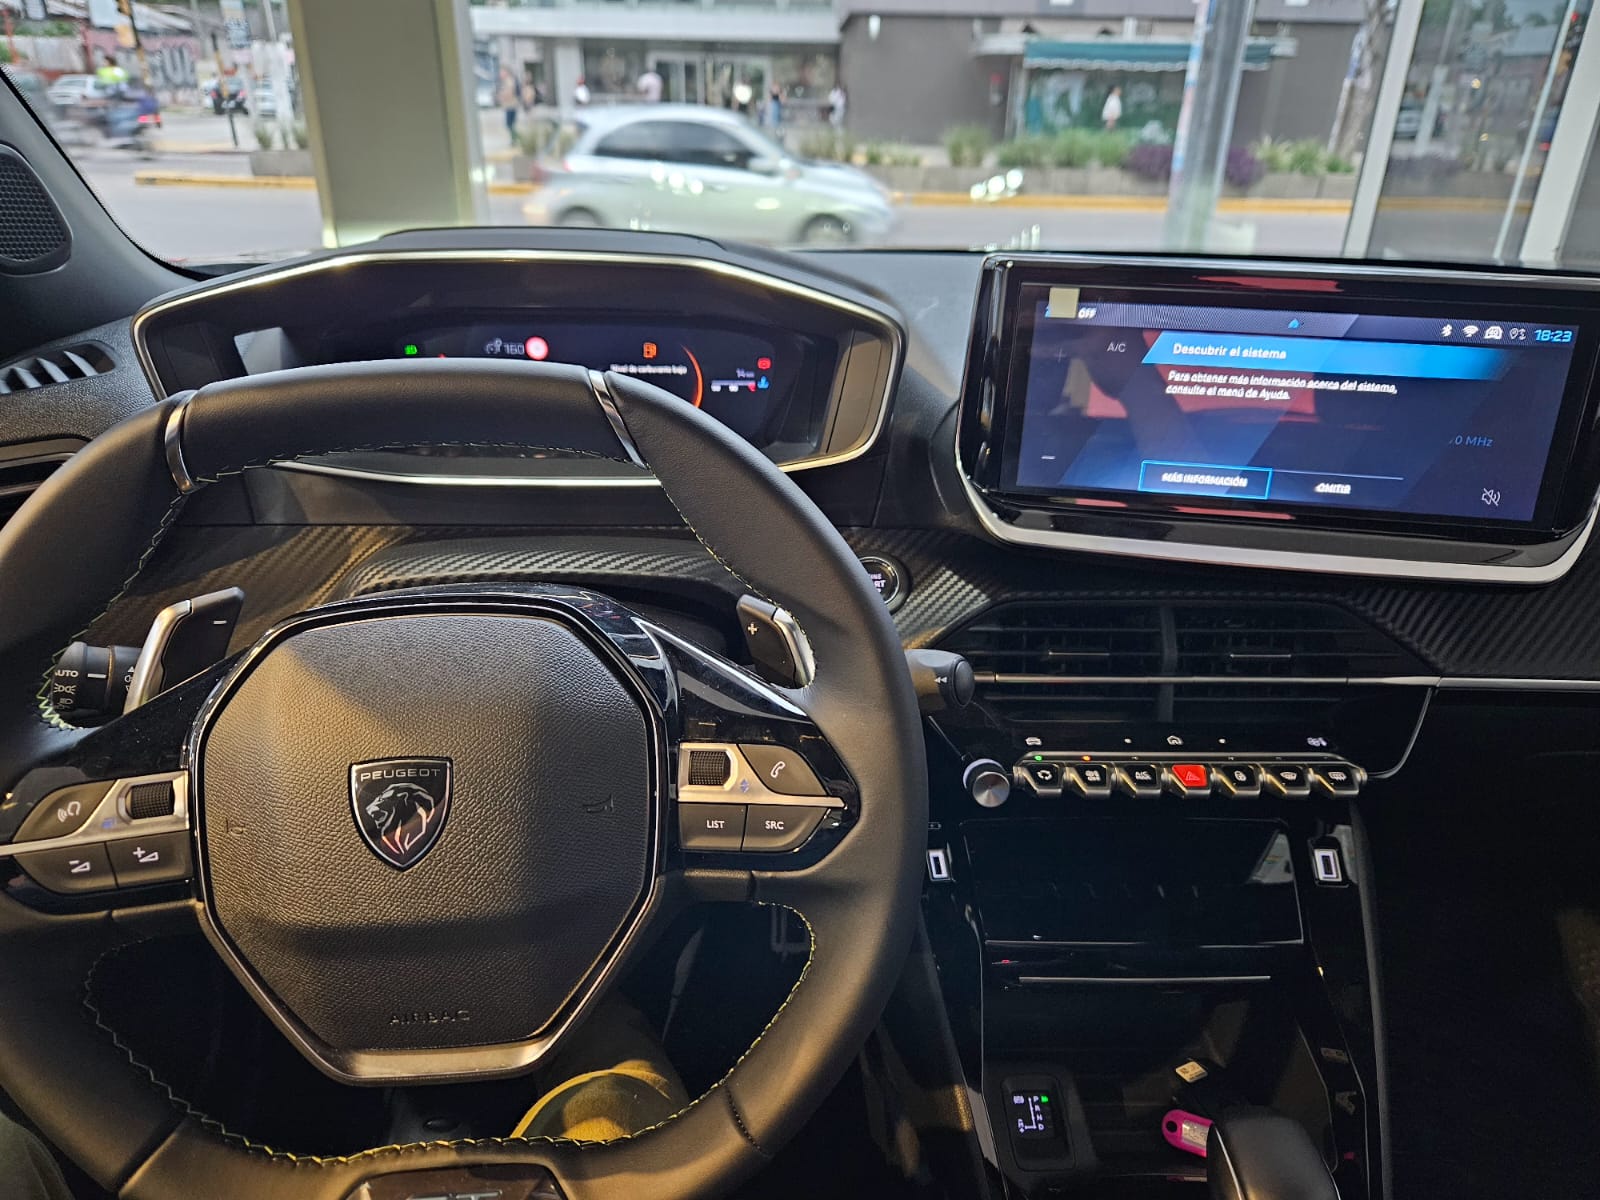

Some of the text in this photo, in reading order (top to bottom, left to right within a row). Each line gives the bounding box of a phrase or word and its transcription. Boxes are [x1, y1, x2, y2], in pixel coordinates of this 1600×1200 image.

[1535, 329, 1573, 342] 18:23
[1107, 342, 1126, 353] A/C
[1172, 343, 1287, 360] Descubrir el sistema
[1168, 370, 1191, 382] Para
[1190, 372, 1228, 384] obtener
[1228, 374, 1249, 386] más
[1249, 375, 1306, 388] información
[1306, 379, 1339, 390] acerca
[1340, 380, 1357, 391] del
[1165, 385, 1206, 396] consulte
[1206, 387, 1217, 396] el
[1217, 388, 1245, 398] menú
[1245, 388, 1259, 399] de
[1465, 436, 1493, 447] MHz
[1161, 472, 1248, 488] MÁS INFORMACIÓN
[360, 768, 441, 782] PEUGEOT
[706, 820, 725, 829] LIST
[765, 820, 784, 830] SRC
